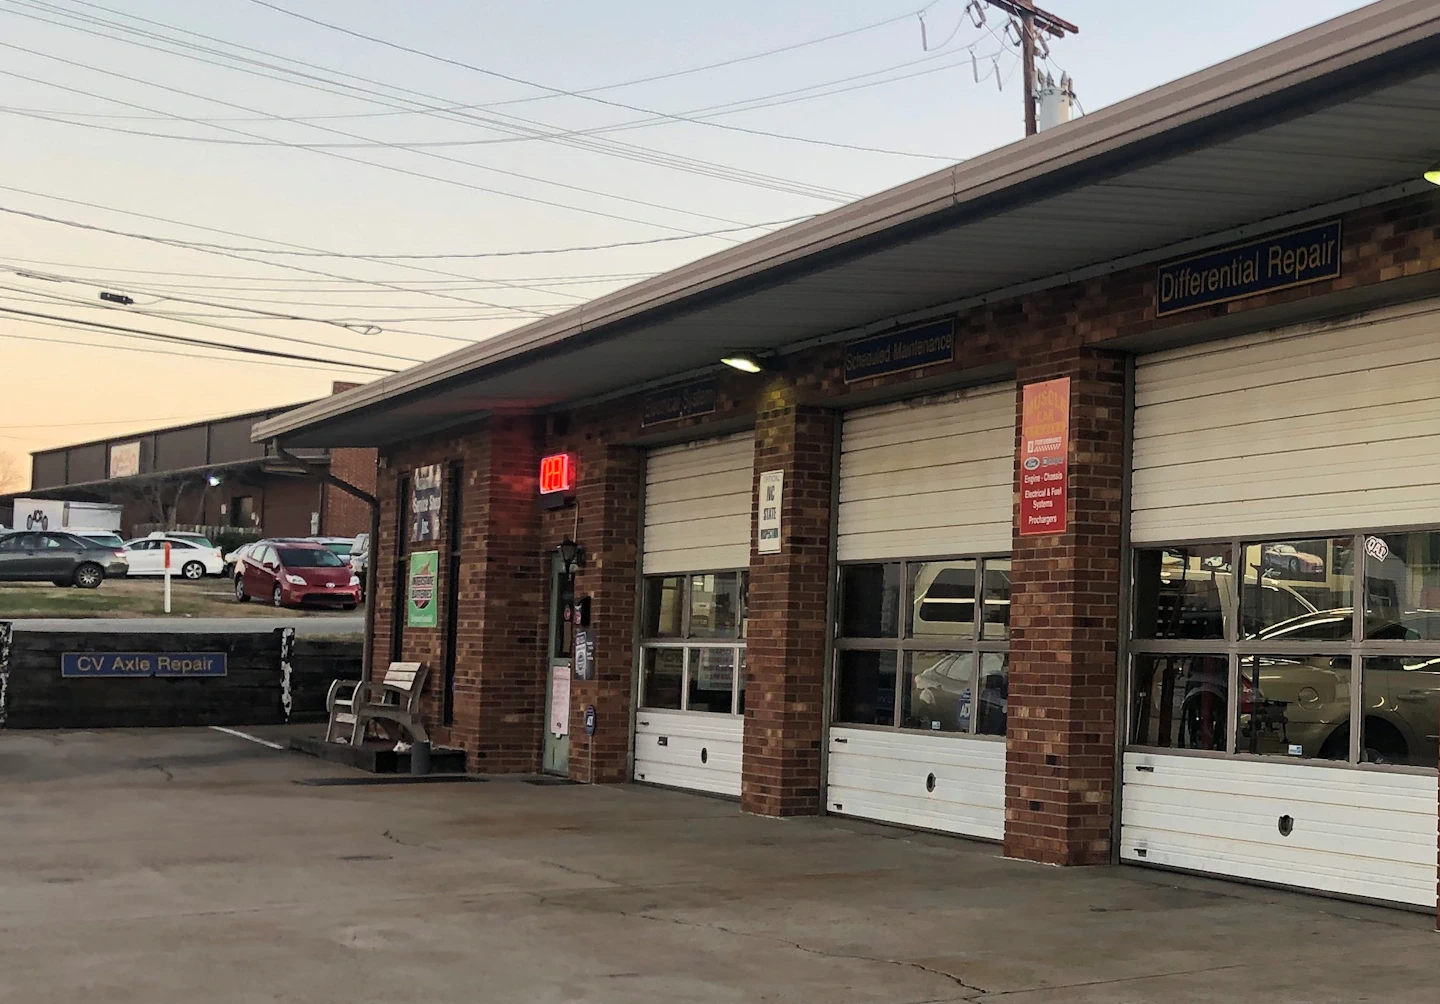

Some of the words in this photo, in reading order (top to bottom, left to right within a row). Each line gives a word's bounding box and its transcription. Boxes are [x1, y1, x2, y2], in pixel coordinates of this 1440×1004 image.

[1161, 251, 1259, 303] Differential
[1267, 233, 1336, 279] Repair
[846, 344, 891, 371] Scheduled
[893, 333, 952, 361] Maintenance
[1024, 474, 1041, 485] Engine
[1043, 471, 1063, 482] Chassis
[1024, 488, 1046, 499] Electrical
[1032, 500, 1053, 510] Systems
[77, 656, 104, 672] CV
[112, 655, 150, 672] Axle
[157, 656, 214, 674] Repair
